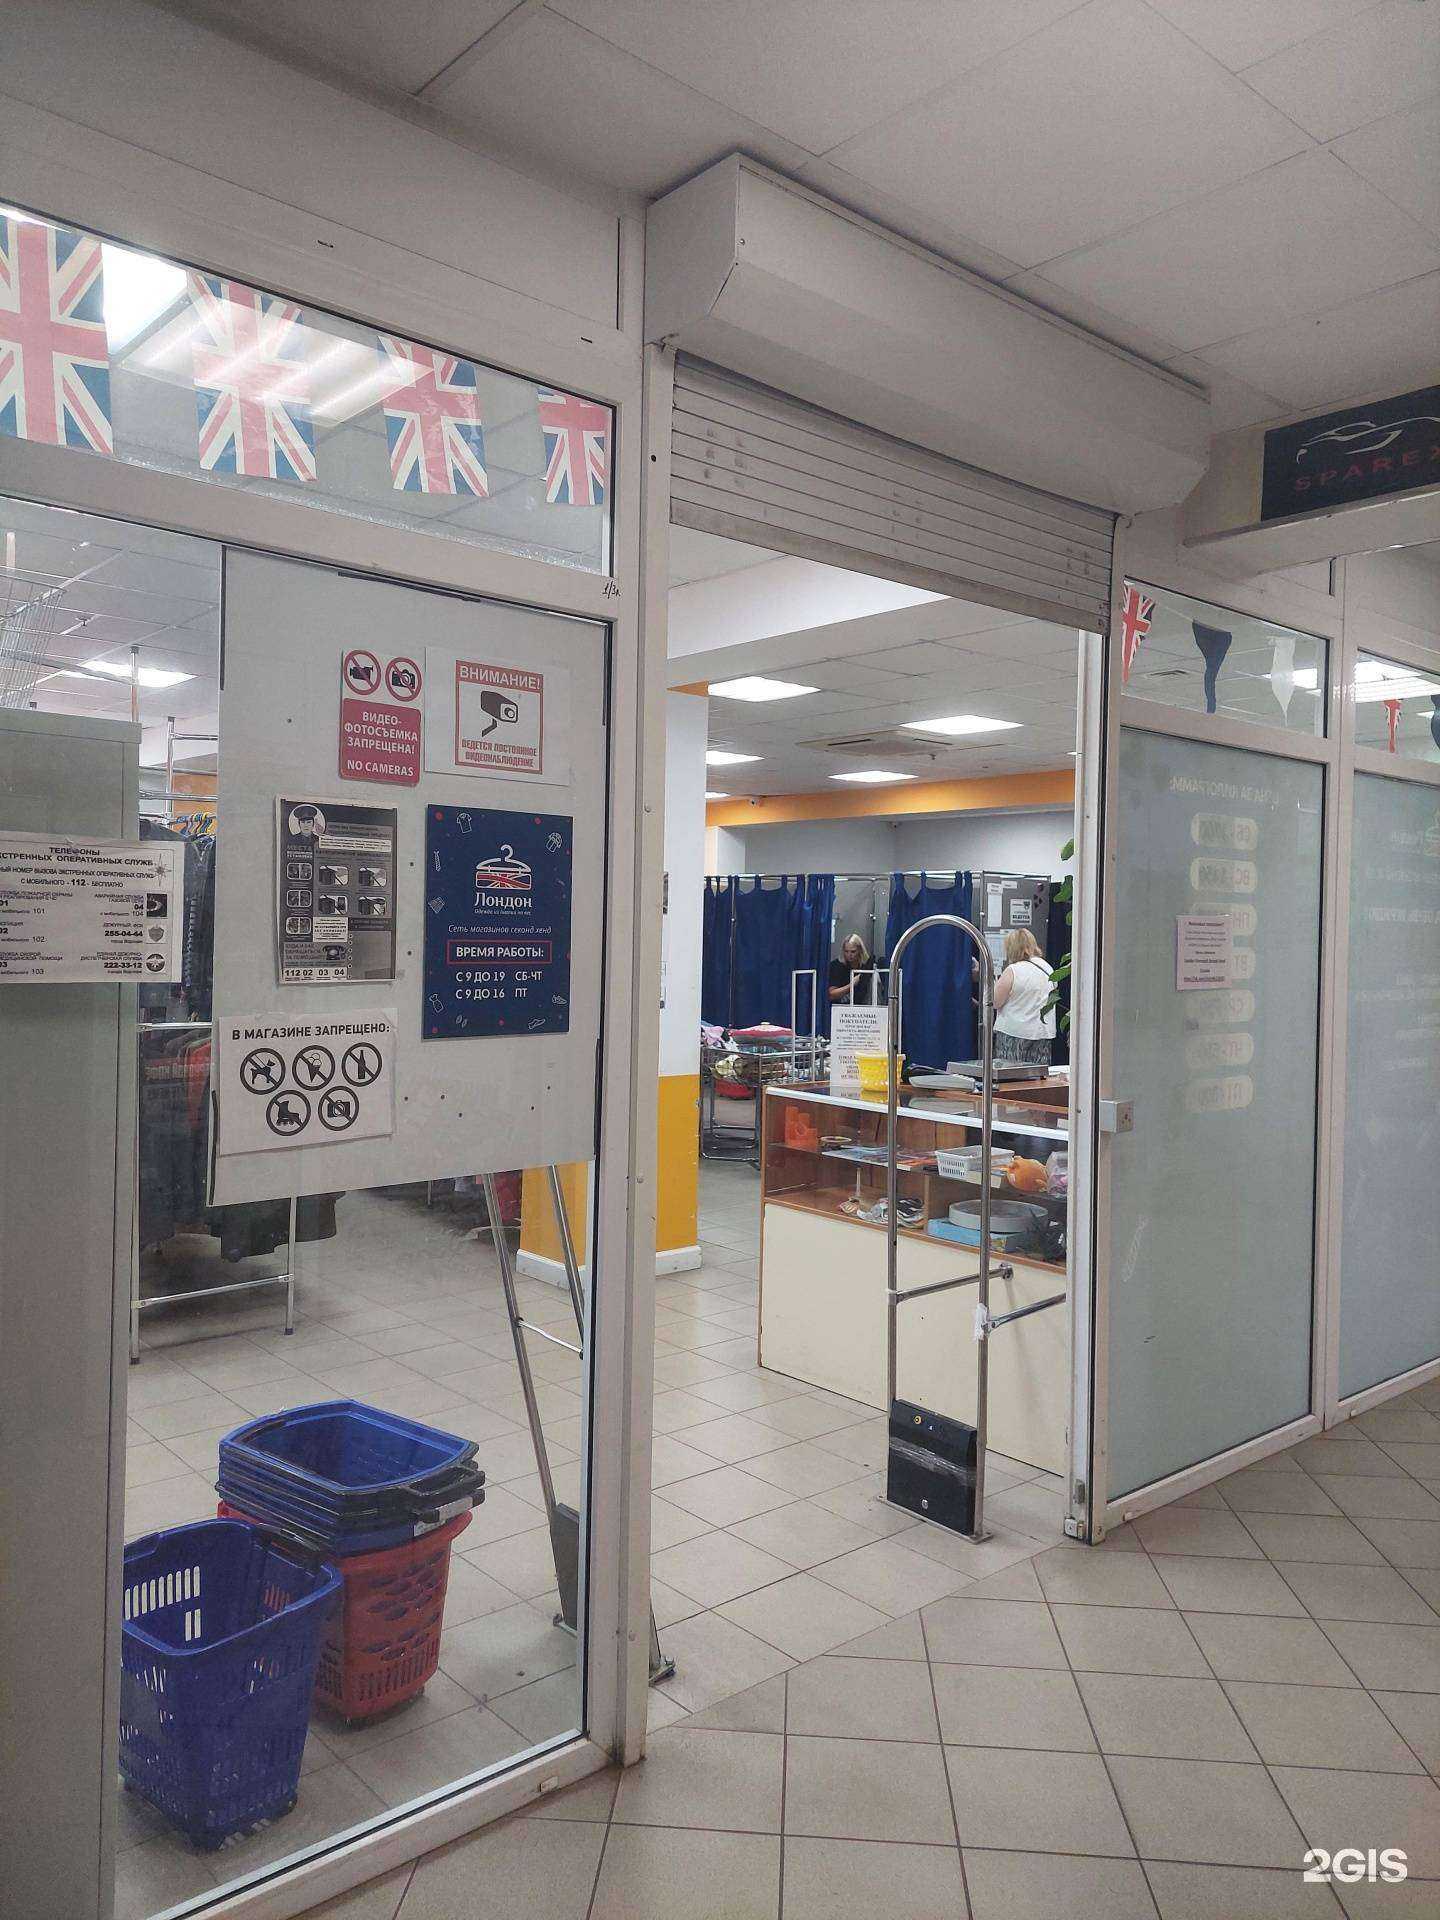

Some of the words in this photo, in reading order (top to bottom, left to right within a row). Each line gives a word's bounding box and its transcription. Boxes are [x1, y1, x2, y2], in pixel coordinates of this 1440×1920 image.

[459, 665, 541, 690] ВНИМАНИЕ!
[362, 711, 402, 726] ВИДЕО-
[344, 723, 418, 742] ФОТОСЪЕМКА
[347, 737, 415, 755] ЗАПРЕЩЕНА!
[461, 739, 493, 751] ВЕДЕТСЯ
[494, 743, 537, 757] ПОСТОЯННОЕ
[465, 751, 534, 768] ВИДЕОНАБЛЮДЕНИЕ
[347, 760, 365, 771] NO
[366, 761, 414, 777] CAMERAS
[49, 847, 100, 856] ТЕЛЕФОНЫ
[57, 855, 122, 865] ОПЕРАТИВНЫХ
[71, 879, 86, 887] 112
[474, 892, 533, 910] Лондон
[448, 924, 468, 934] Сеть
[470, 926, 509, 934] магазинов
[510, 926, 534, 935] секонд
[535, 926, 552, 935] хенд
[456, 946, 494, 957] ВРЕМЯ
[497, 946, 544, 957] РАБОТЫ:
[285, 969, 301, 977] 112
[455, 972, 463, 982] С
[465, 972, 472, 982] 9
[473, 971, 491, 983] ДО
[494, 971, 506, 982] 19
[515, 971, 543, 981] СБ-ЧТ
[455, 989, 463, 999] С
[465, 989, 472, 999] 9
[473, 988, 491, 1000] ДО
[493, 988, 505, 998] 16
[515, 987, 528, 998] ПТ
[232, 1029, 241, 1041] В
[244, 1027, 311, 1040] МАГАЗИНЕ
[315, 1022, 390, 1036] ЗАПРЕЩЕНО:
